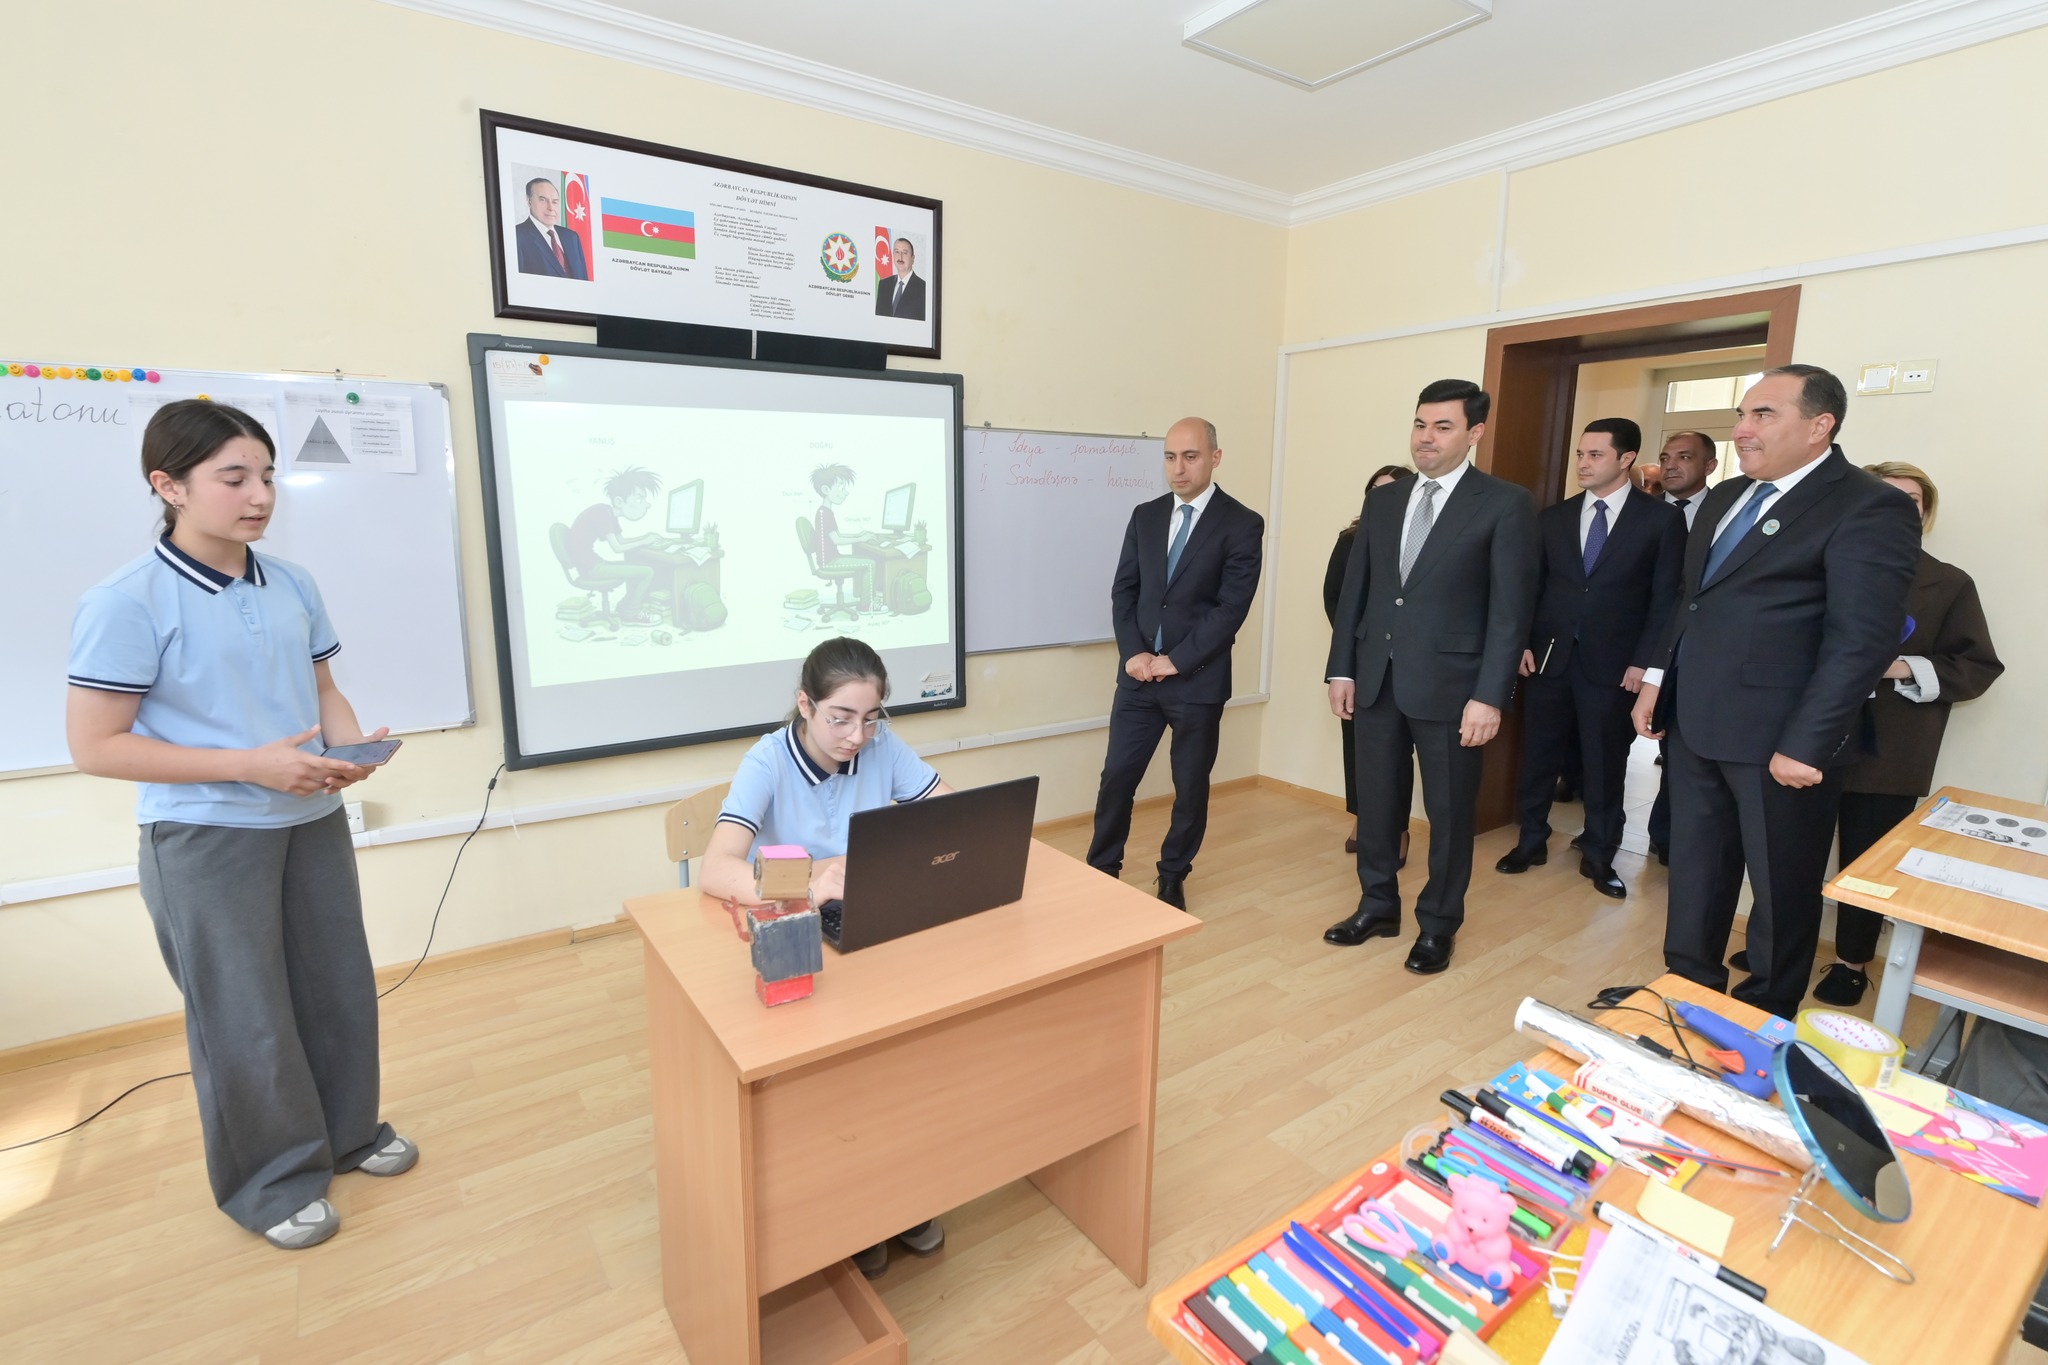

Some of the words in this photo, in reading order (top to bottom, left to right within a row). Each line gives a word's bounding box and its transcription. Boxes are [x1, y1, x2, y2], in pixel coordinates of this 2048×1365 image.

[612, 258, 646, 266] AZƏRBAYCAN
[0, 386, 127, 426] atonu
[931, 851, 960, 866] acer
[1591, 1085, 1618, 1103] SUPER
[1620, 1100, 1643, 1115] GLUE
